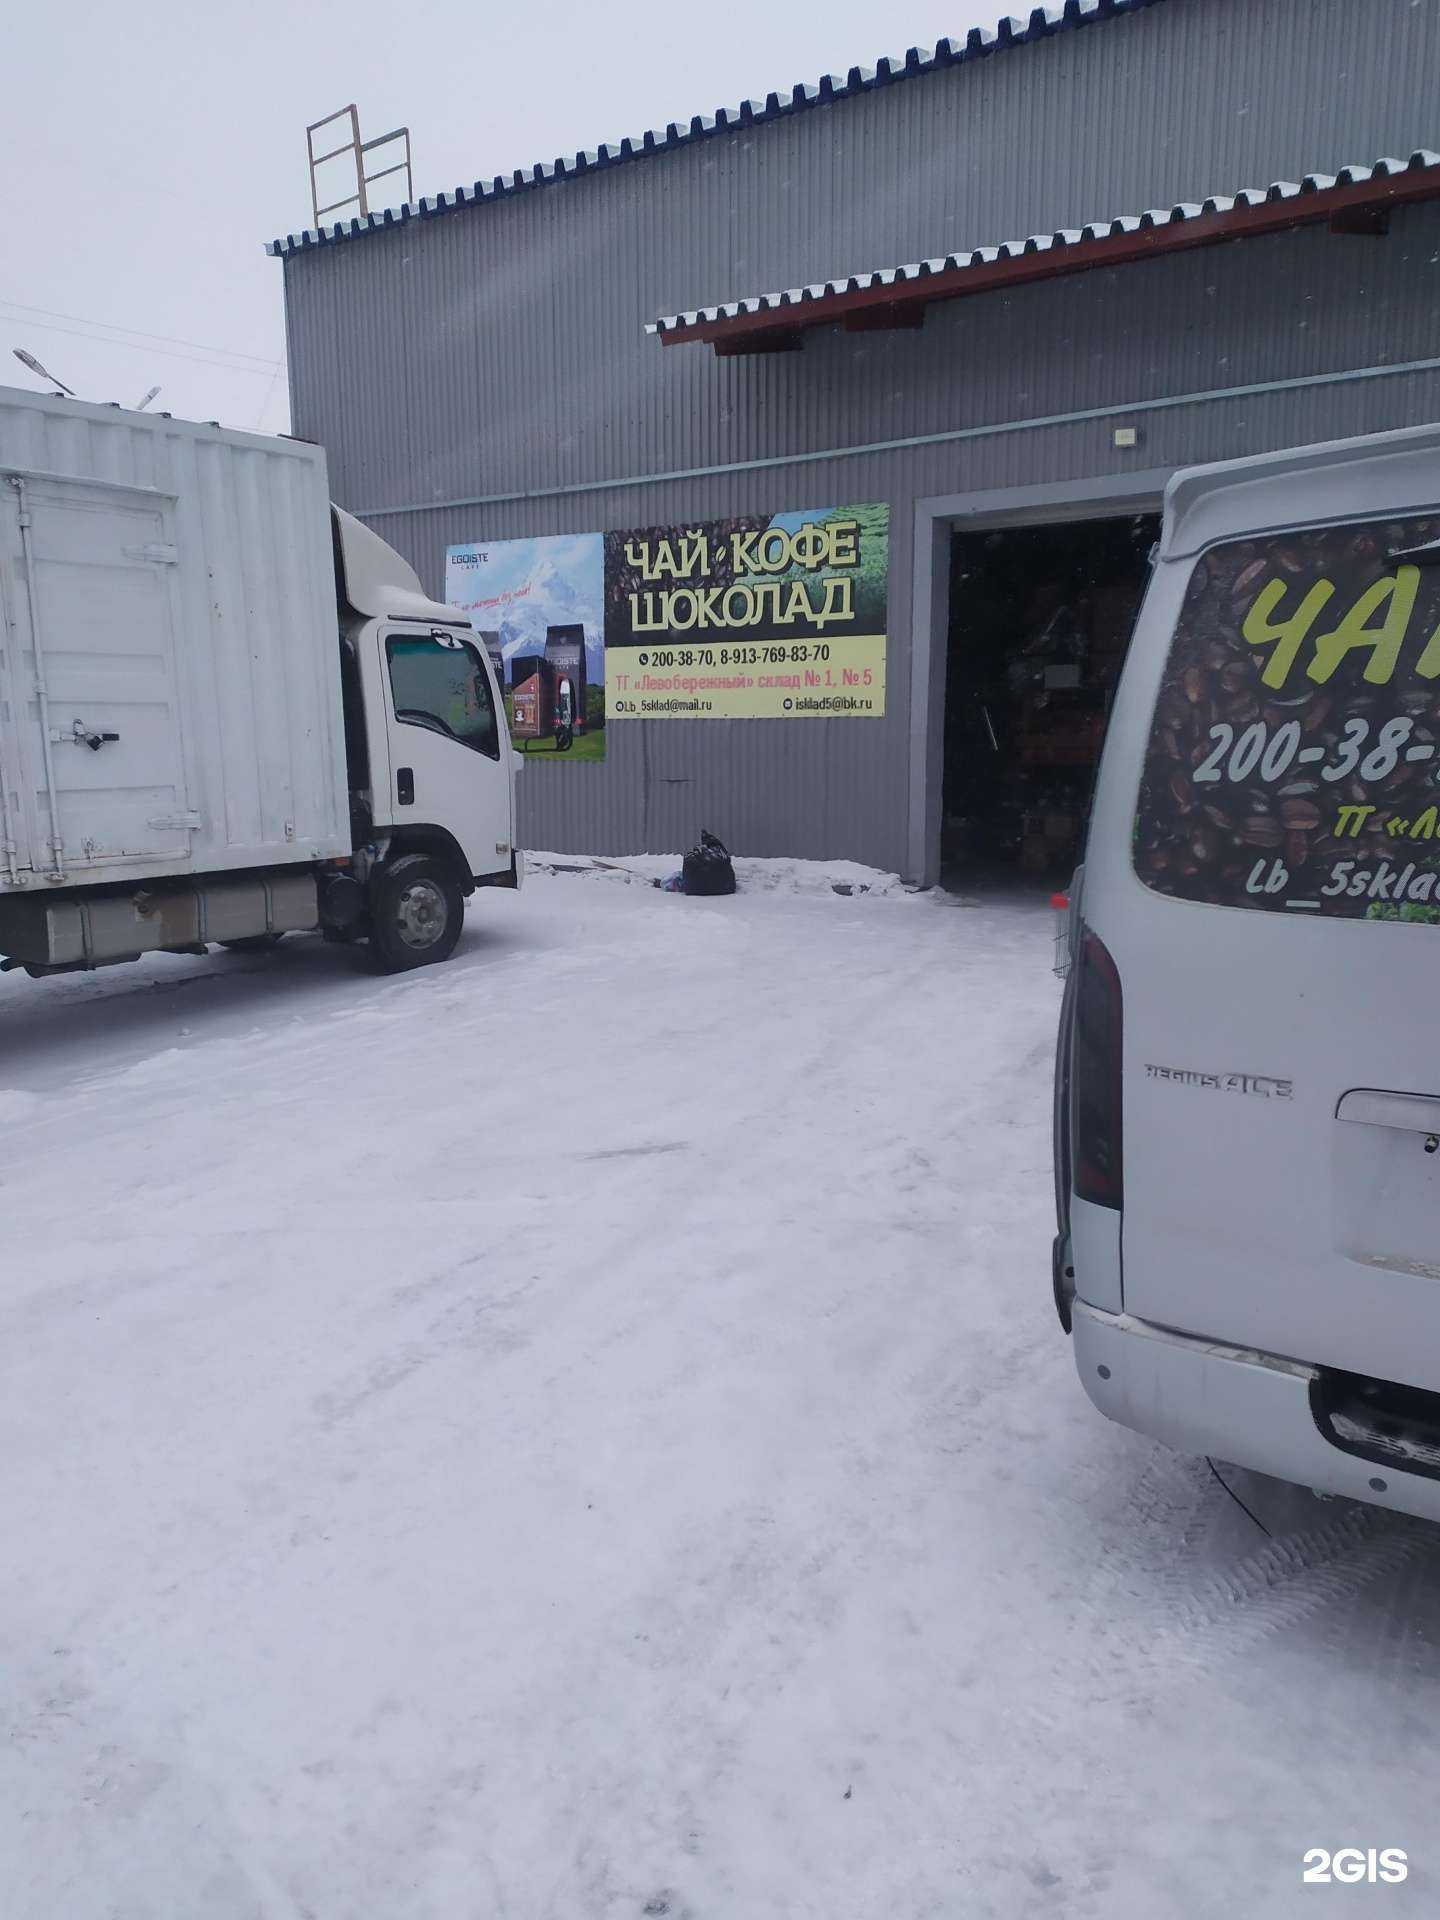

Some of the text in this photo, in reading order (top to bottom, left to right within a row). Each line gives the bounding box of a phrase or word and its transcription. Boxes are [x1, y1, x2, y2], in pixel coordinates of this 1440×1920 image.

[451, 553, 488, 564] EGOISTE
[624, 520, 860, 580] ЧАЙ КОФЕ
[628, 577, 855, 632] ШОКОЛАД
[651, 644, 830, 667] 200-38-70, 8-913-769-83-70
[757, 674, 801, 689] склад
[804, 669, 821, 686] №
[842, 668, 859, 685] №
[863, 668, 872, 685] 5
[1192, 717, 1440, 783] 200-38-
